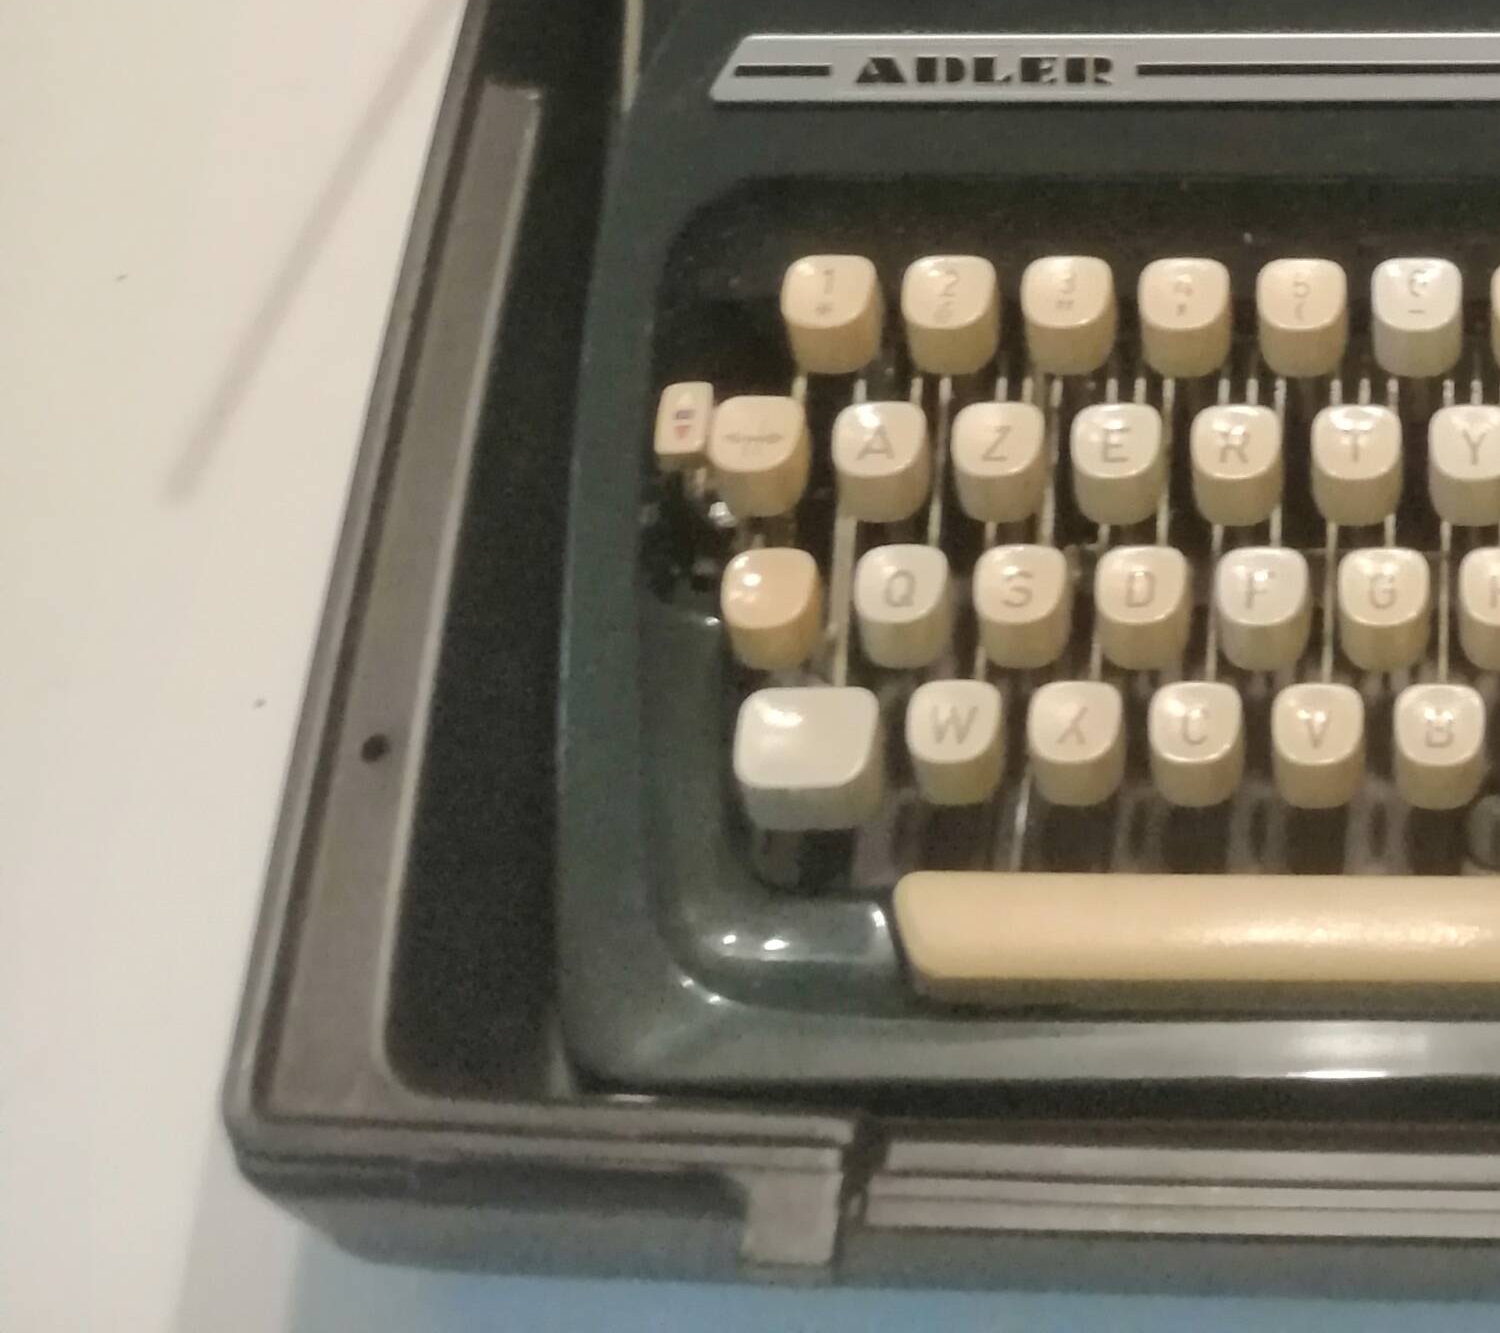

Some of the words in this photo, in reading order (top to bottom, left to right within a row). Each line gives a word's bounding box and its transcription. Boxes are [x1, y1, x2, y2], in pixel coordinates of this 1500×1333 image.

[855, 55, 1114, 85] ADLER
[937, 267, 959, 297] 2
[857, 422, 895, 462] A
[981, 425, 1012, 463] Z
[1102, 427, 1132, 464] E
[1218, 425, 1250, 464] R
[1341, 428, 1370, 463] T
[1462, 429, 1488, 466] Y
[884, 569, 916, 609] Q
[1002, 570, 1034, 609] S
[1125, 569, 1155, 609] D
[1244, 570, 1276, 610] F
[1367, 572, 1398, 611] G
[930, 705, 978, 745] W
[1181, 708, 1209, 746] C
[1302, 710, 1332, 750] V
[1423, 709, 1456, 749] B
